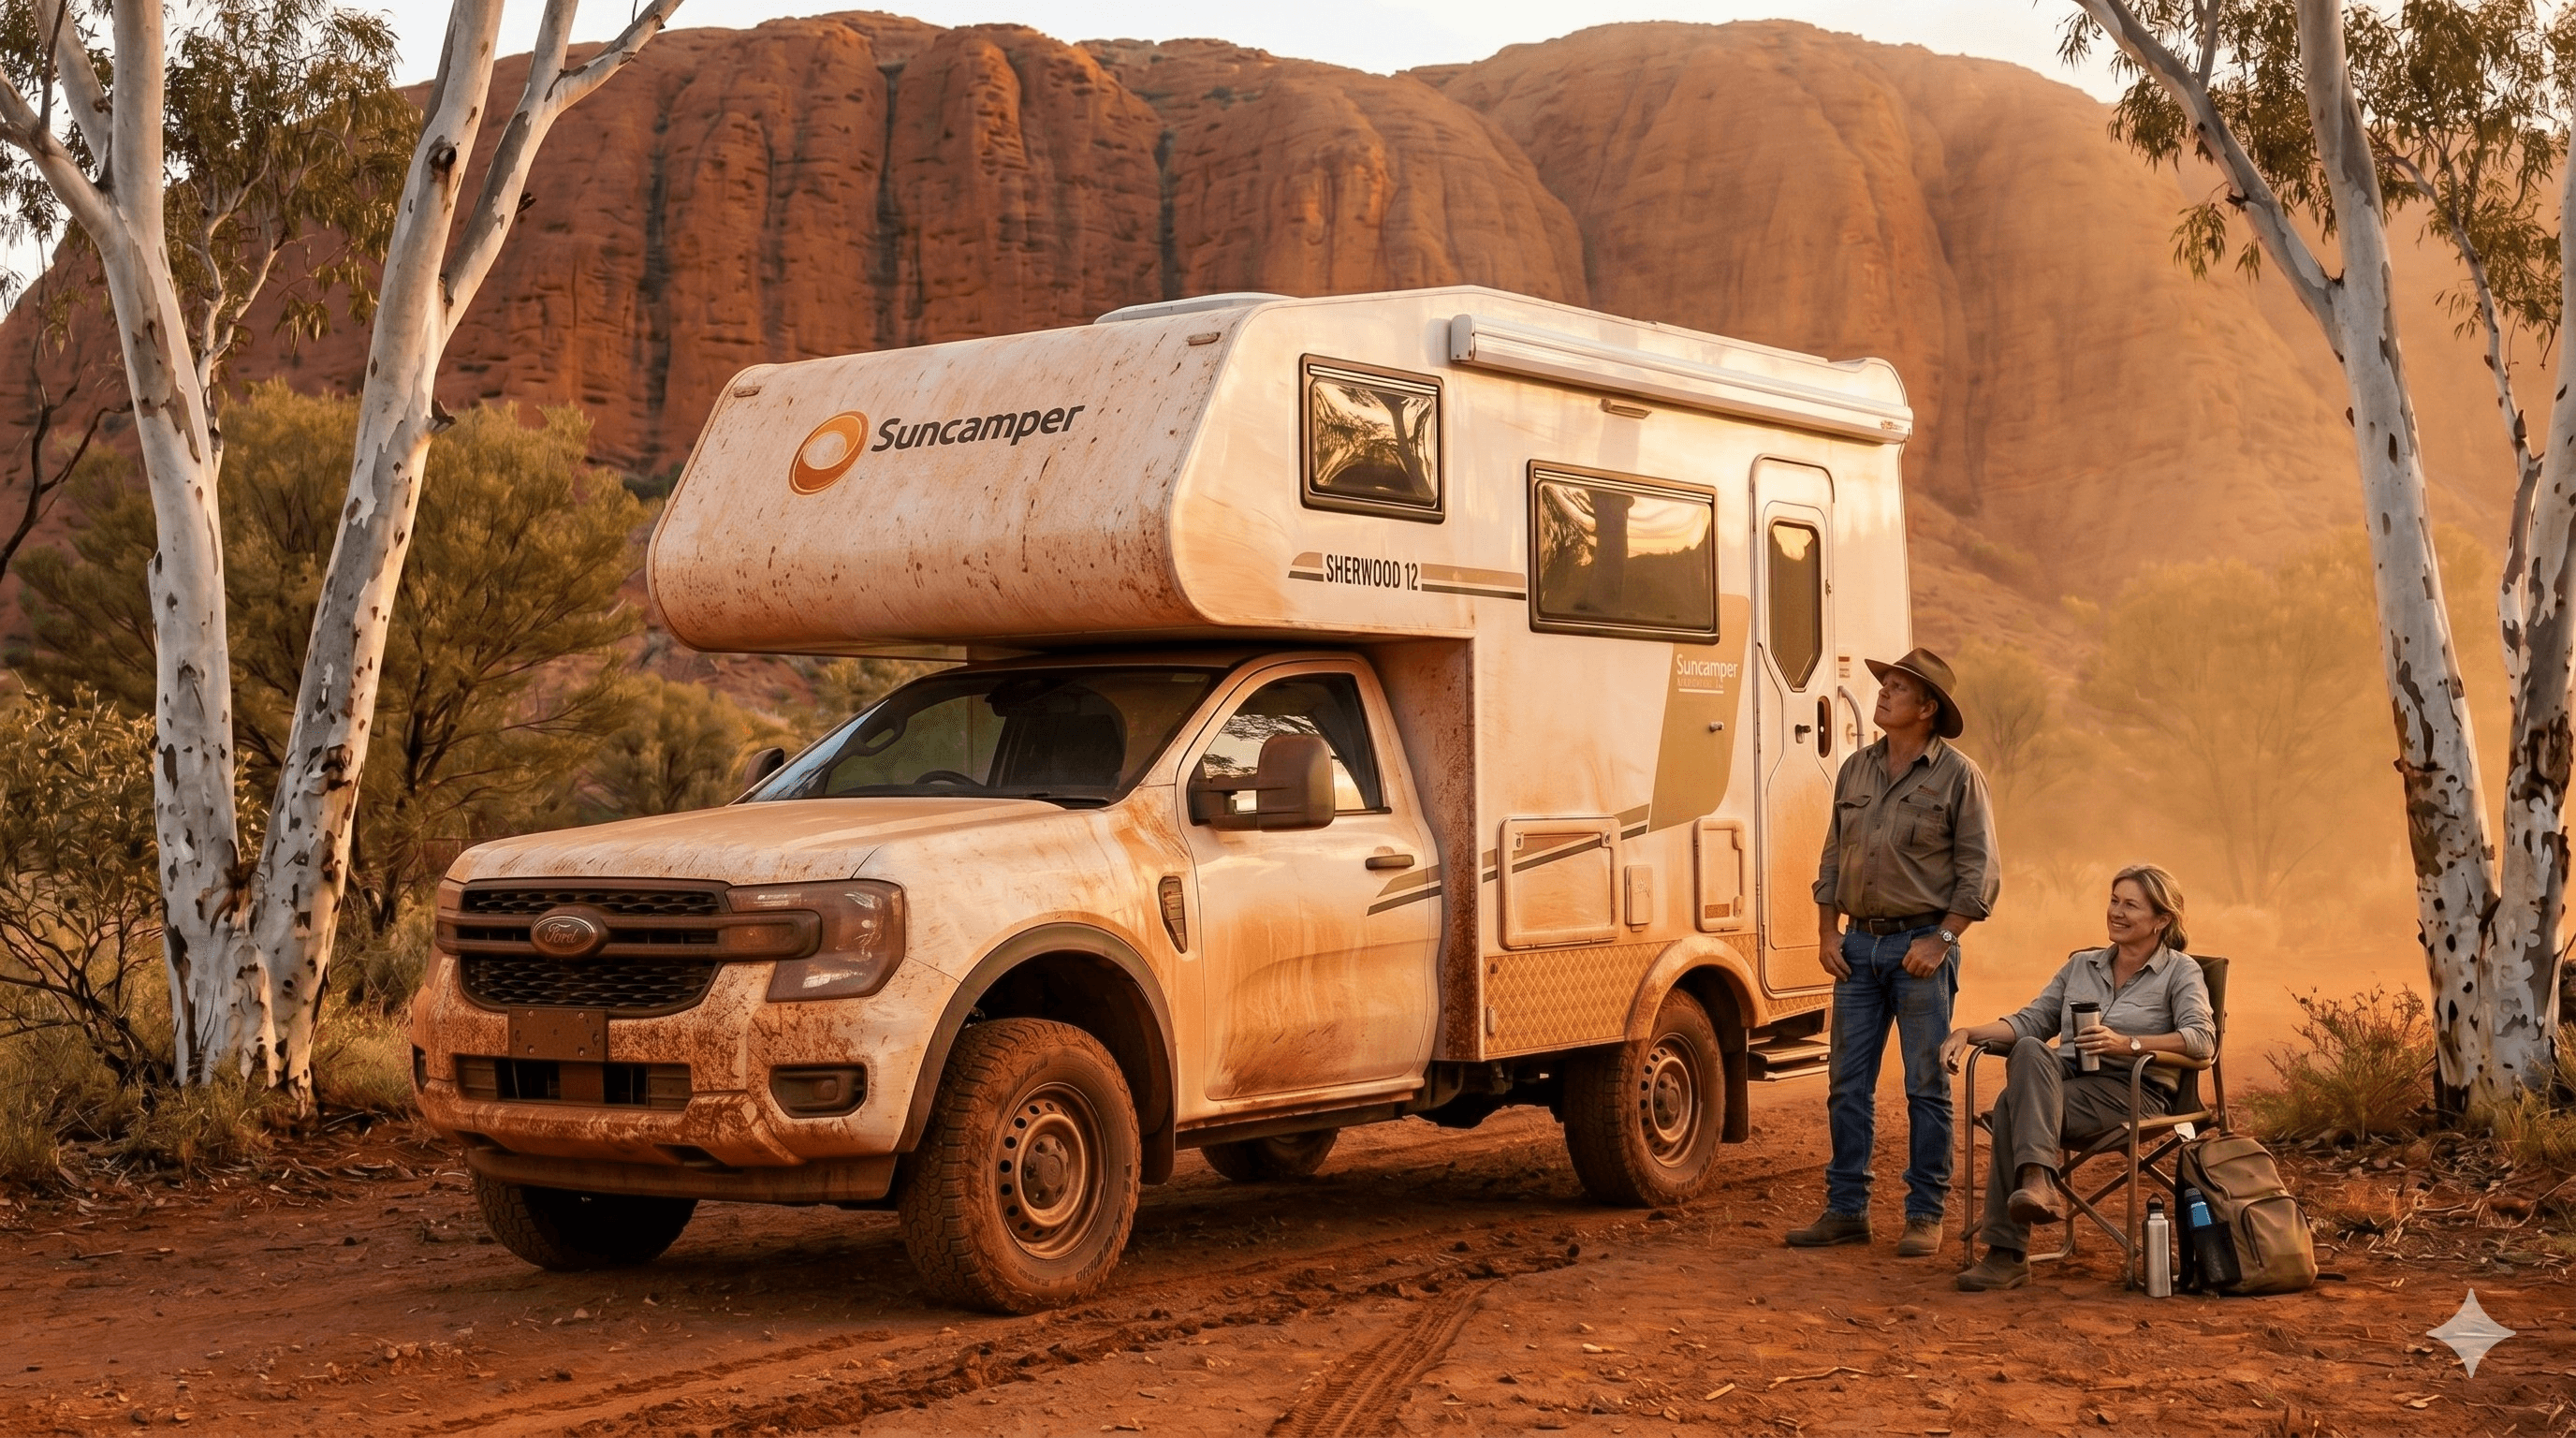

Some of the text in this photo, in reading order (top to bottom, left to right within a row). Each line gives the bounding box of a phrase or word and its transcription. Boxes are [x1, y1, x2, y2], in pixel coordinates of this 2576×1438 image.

[871, 404, 1086, 452] Suncamper
[1325, 553, 1418, 591] SHERWOOD 12
[1676, 653, 1738, 683] Suncamper
[545, 922, 578, 944] Ford
